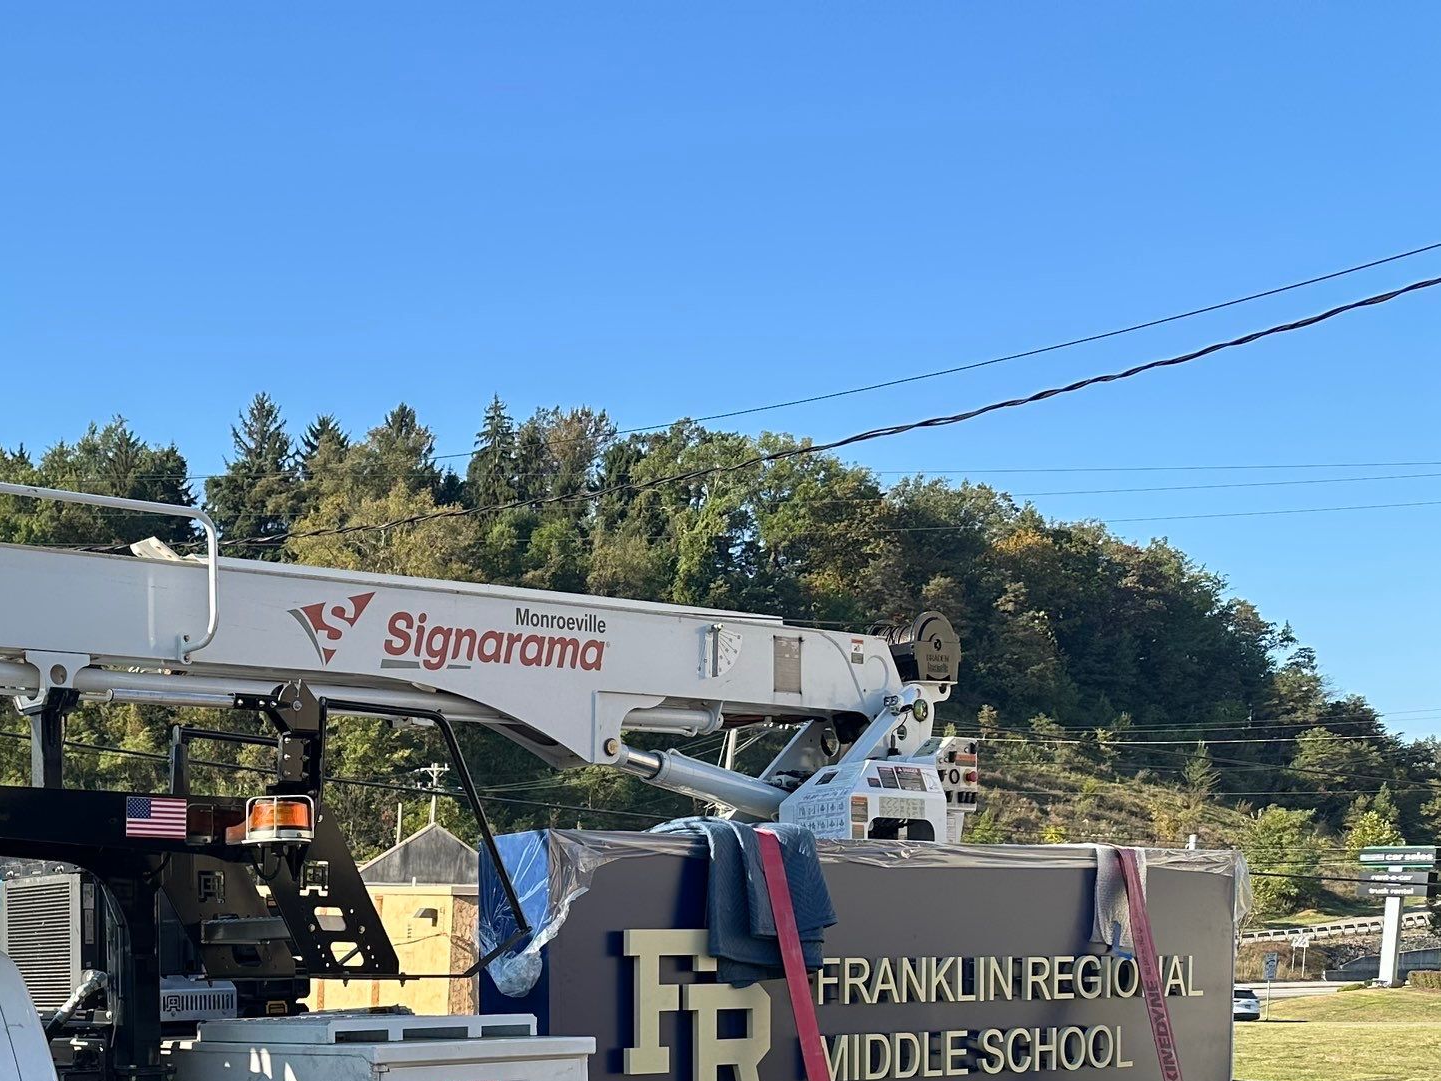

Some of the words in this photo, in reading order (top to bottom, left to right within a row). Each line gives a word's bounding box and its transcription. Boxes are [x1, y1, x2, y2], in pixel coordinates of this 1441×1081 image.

[383, 611, 605, 672] Signarama
[515, 607, 606, 634] Monroeville
[1404, 852, 1434, 860] sales
[818, 955, 1014, 1005] FRANKLIN
[1028, 954, 1204, 1000] REGIOAL
[820, 1028, 968, 1081] MIDDLE
[977, 1023, 1134, 1075] SCHOOL
